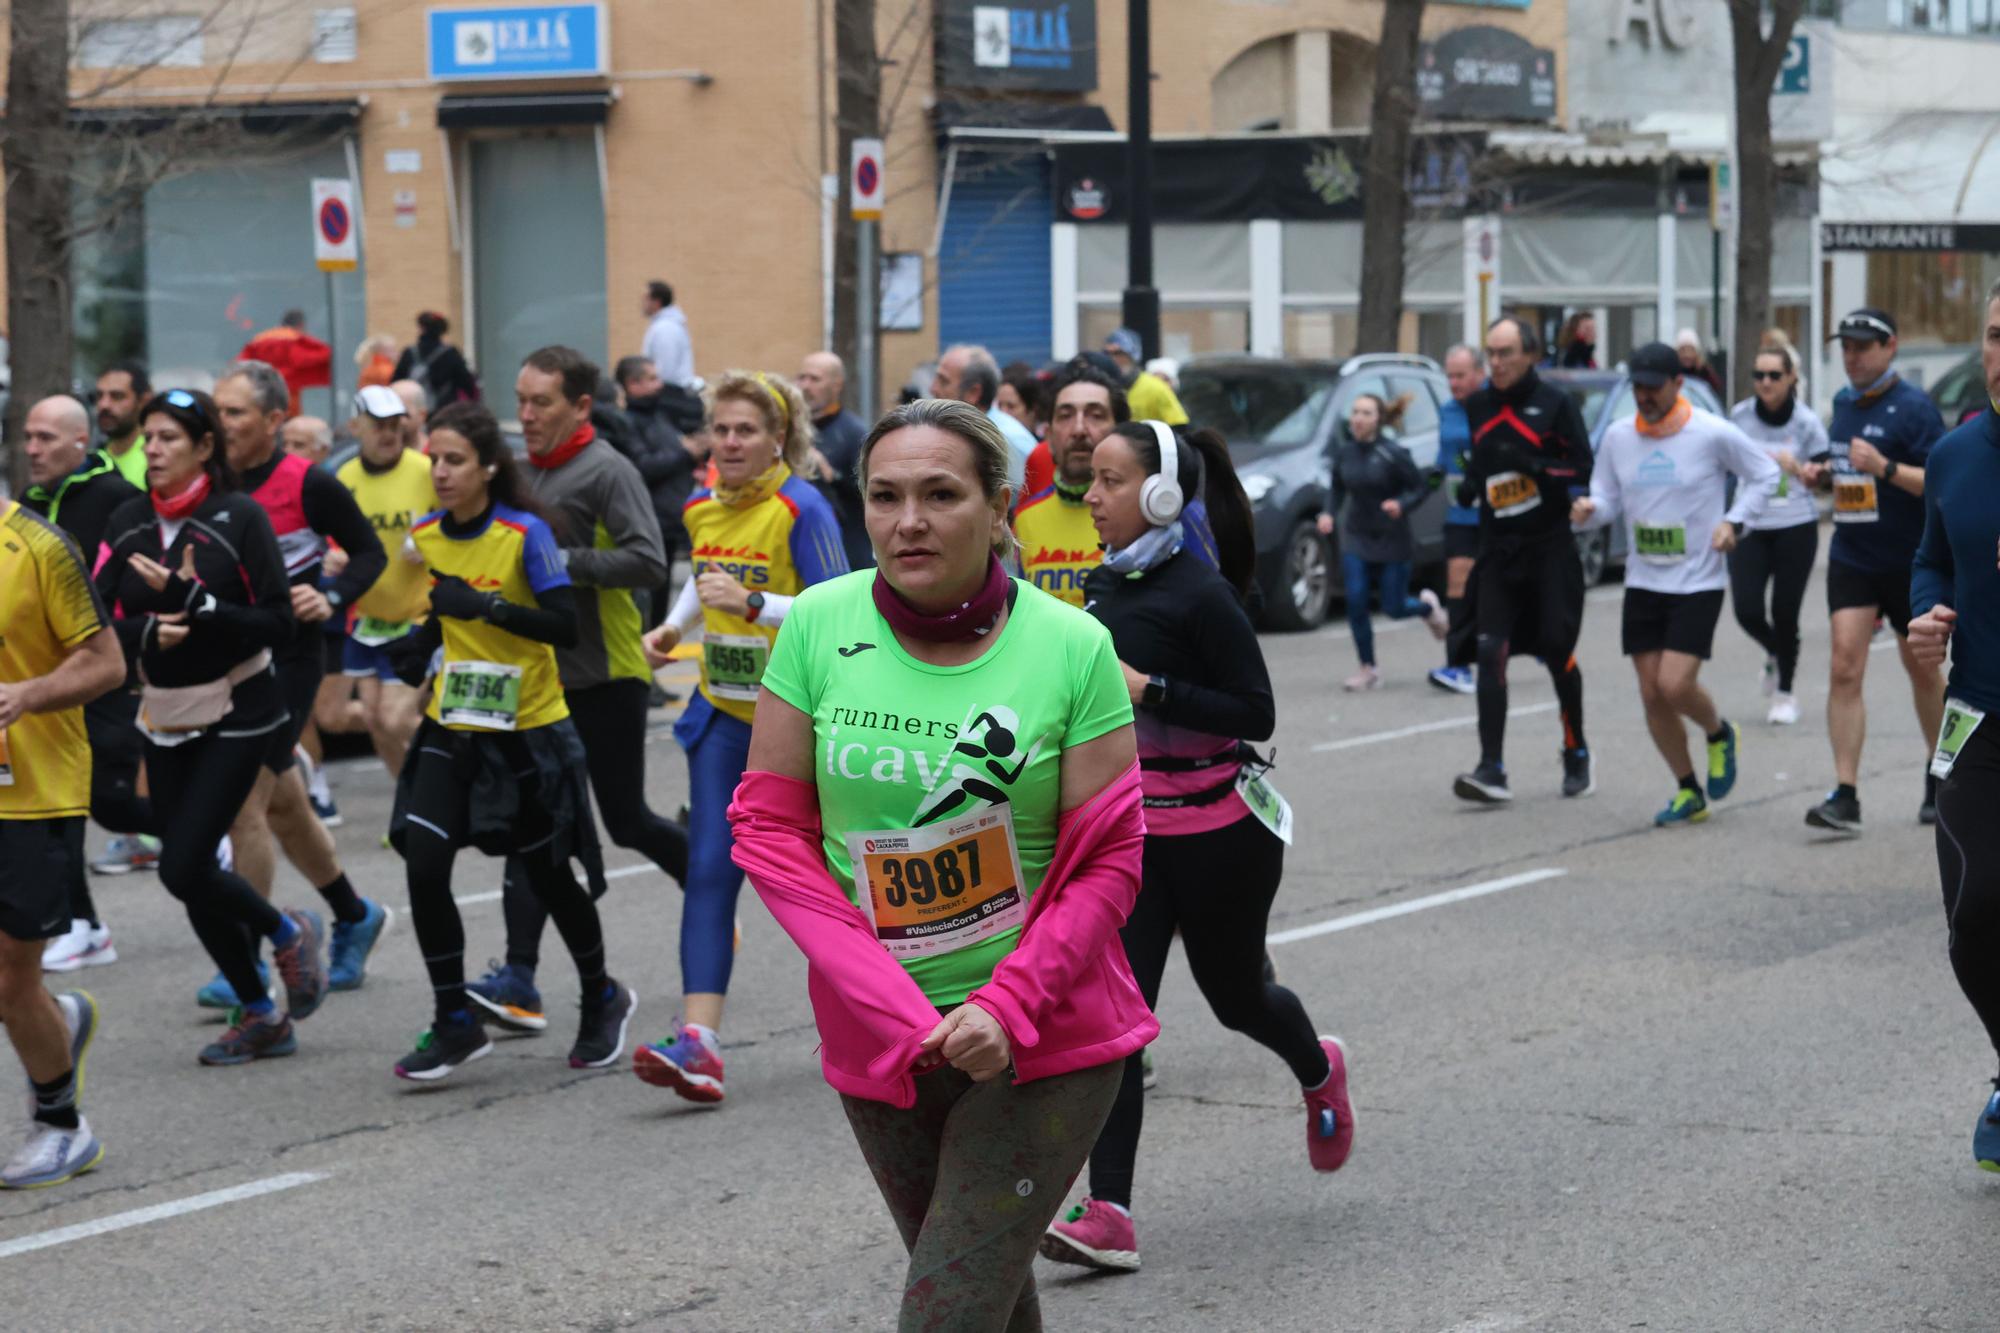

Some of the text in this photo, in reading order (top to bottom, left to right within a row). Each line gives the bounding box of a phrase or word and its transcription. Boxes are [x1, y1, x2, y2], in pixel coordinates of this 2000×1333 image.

[710, 646, 755, 675] 4565
[449, 673, 505, 702] 4564
[831, 706, 959, 740] runners
[826, 726, 951, 793] icav
[882, 838, 982, 908] 3987
[917, 899, 962, 915] PREFERENT
[905, 912, 978, 936] #ValènciaCorre
